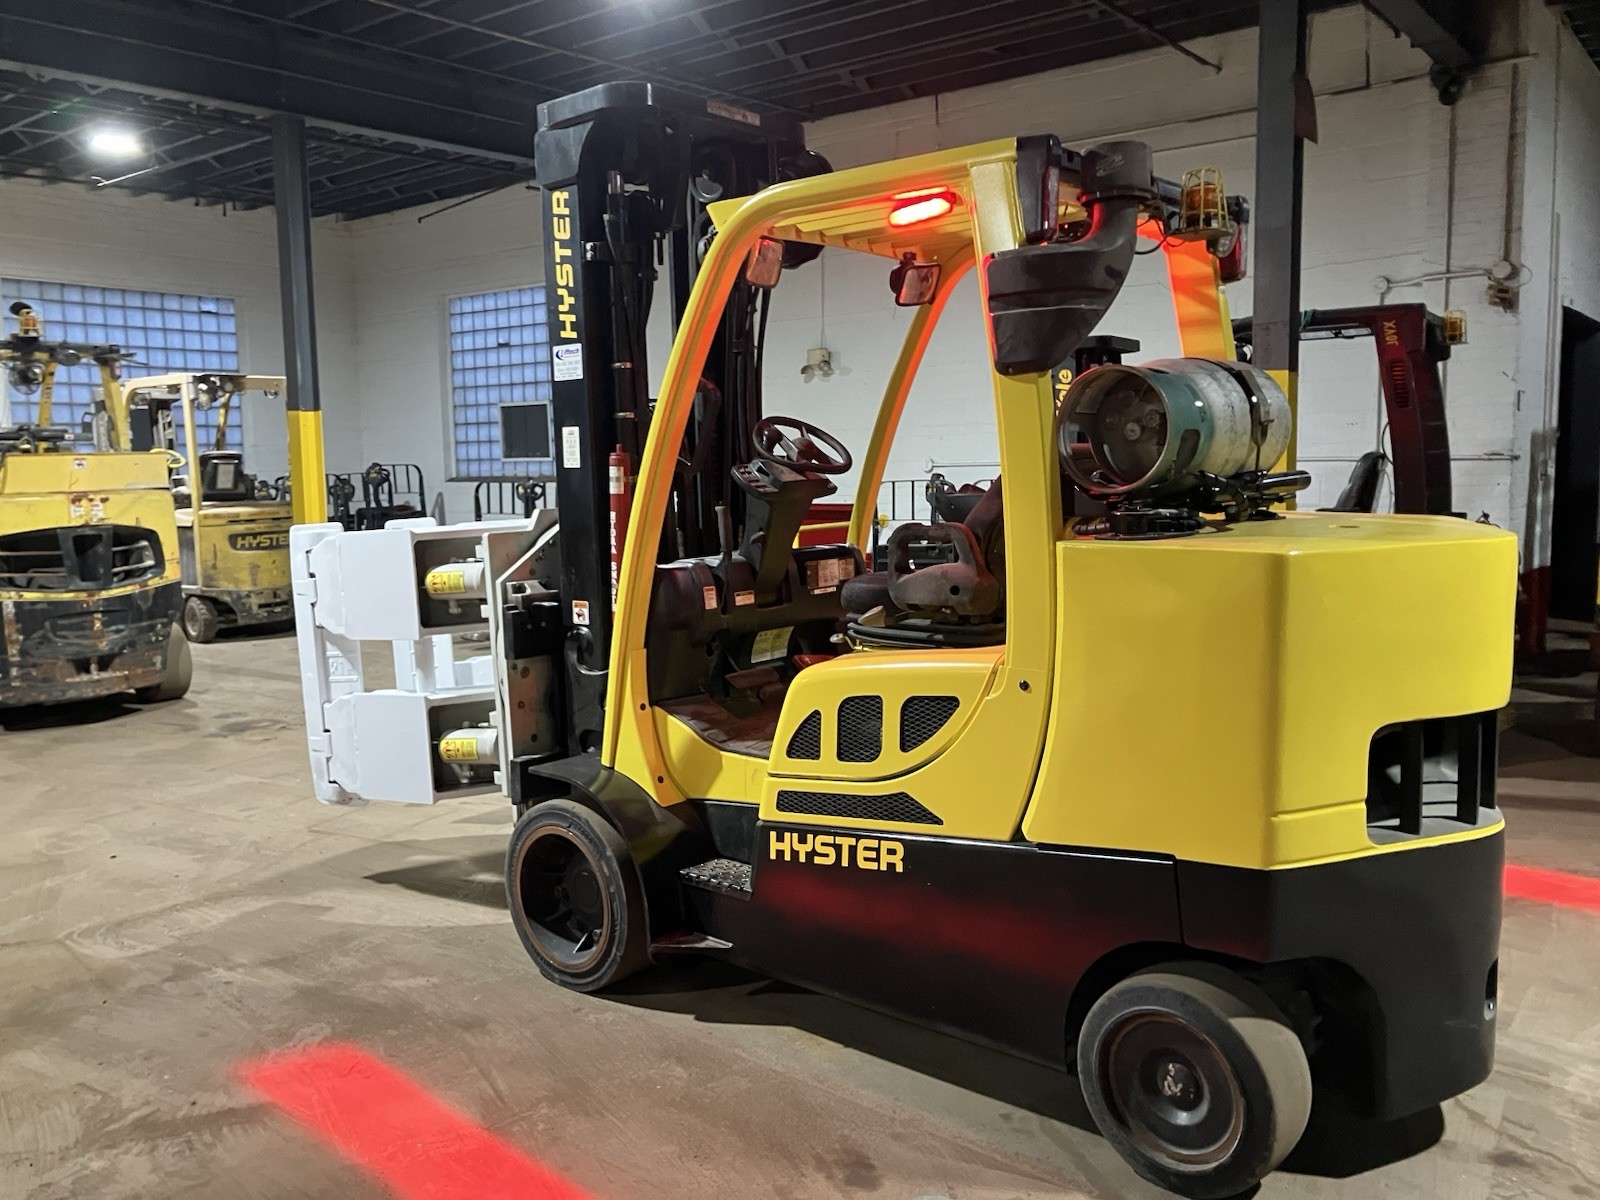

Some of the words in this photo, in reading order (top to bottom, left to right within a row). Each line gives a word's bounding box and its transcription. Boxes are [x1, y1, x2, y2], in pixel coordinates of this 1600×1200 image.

[552, 191, 578, 339] HYSTER
[1055, 369, 1072, 416] ale
[236, 533, 288, 549] HYSTE
[769, 831, 905, 873] HYSTER
